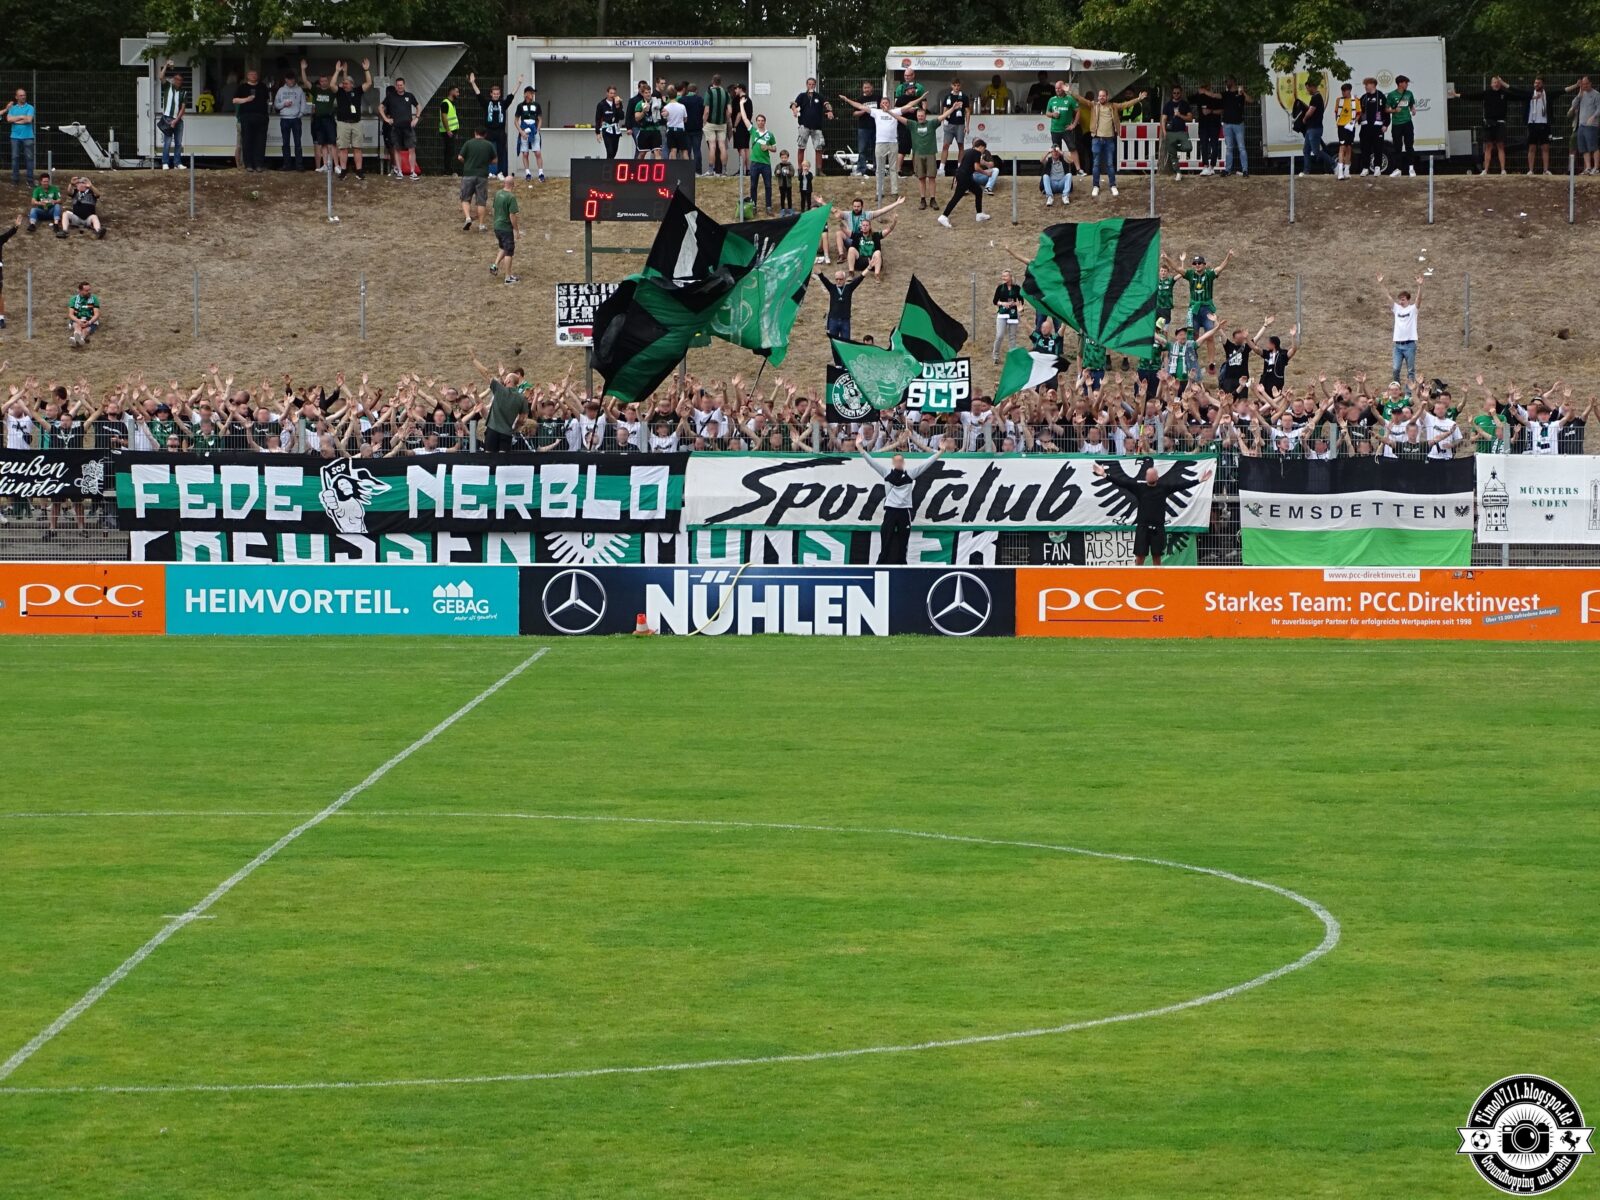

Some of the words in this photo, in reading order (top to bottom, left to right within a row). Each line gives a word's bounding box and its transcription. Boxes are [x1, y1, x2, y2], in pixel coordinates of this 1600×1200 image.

[201, 100, 207, 112] 5
[616, 164, 665, 182] 0:00
[585, 200, 597, 218] 0
[558, 283, 619, 295] SEKTIO
[558, 294, 611, 307] STADI
[558, 306, 598, 320] VER
[920, 360, 969, 379] ORZA
[906, 381, 969, 408] SCP
[0, 455, 69, 478] eußen
[0, 477, 70, 498] ünster
[131, 464, 304, 521] FEDE
[407, 464, 670, 520] NERBLO
[1520, 485, 1579, 495] MÜNSTERS
[1269, 502, 1447, 519] EMSDETTEN
[1532, 499, 1568, 508] SÜDEN
[1086, 531, 1134, 542] BESTE
[1043, 542, 1071, 561] FAN
[1086, 542, 1114, 560] AUS
[1117, 542, 1134, 559] DE
[1328, 571, 1416, 580] www.pcc-direktinvest.eu
[186, 588, 409, 614] HEIMVORTEIL.
[433, 599, 489, 614] GEBAG
[645, 570, 890, 636] NÜHLEN
[1204, 591, 1284, 612] Starkes
[1289, 591, 1352, 612] Team:
[1359, 591, 1541, 612] PCC.Direktinvest
[131, 610, 143, 618] SE
[1282, 618, 1324, 627] zuverlässiger
[1361, 618, 1400, 627] erfolgreiche
[1401, 618, 1441, 627] Wertpapiere
